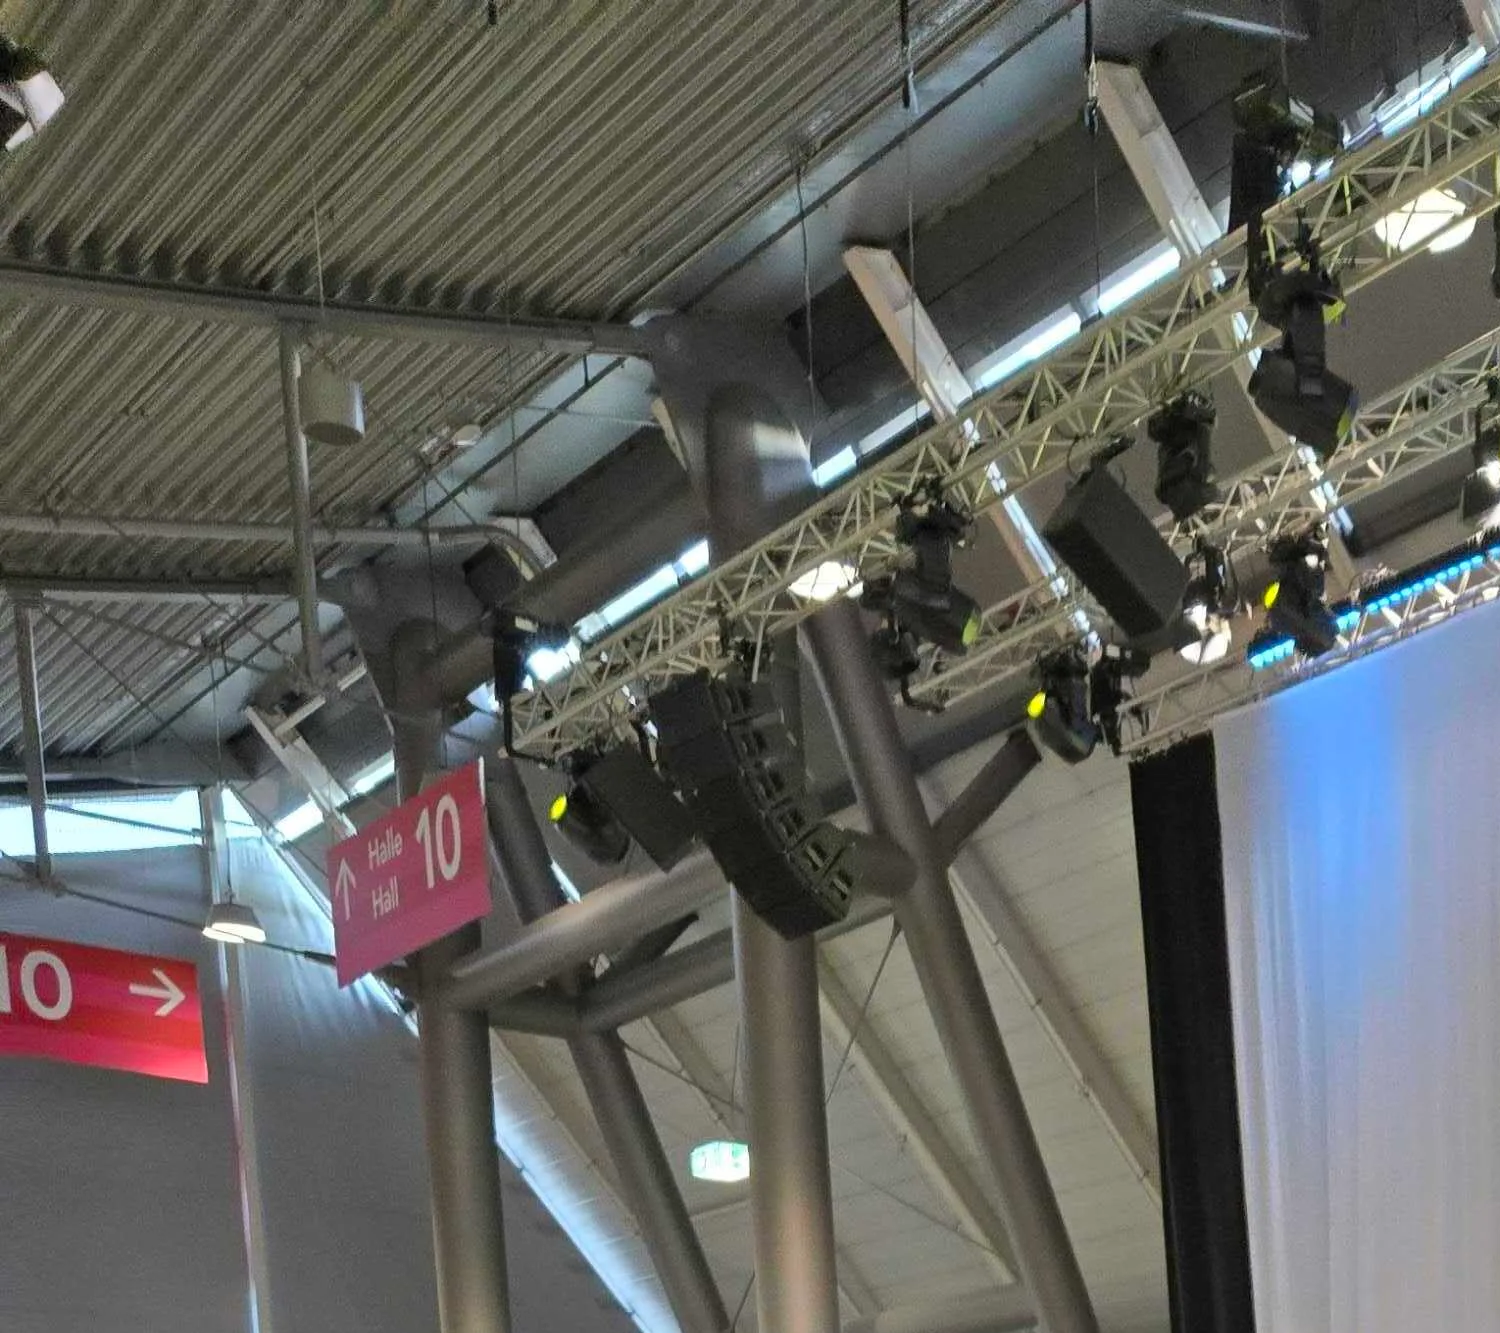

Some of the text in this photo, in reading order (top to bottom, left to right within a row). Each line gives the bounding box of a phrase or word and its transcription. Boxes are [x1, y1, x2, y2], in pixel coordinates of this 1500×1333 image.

[368, 829, 403, 870] Halle
[415, 793, 462, 889] 10
[371, 885, 400, 920] Hall
